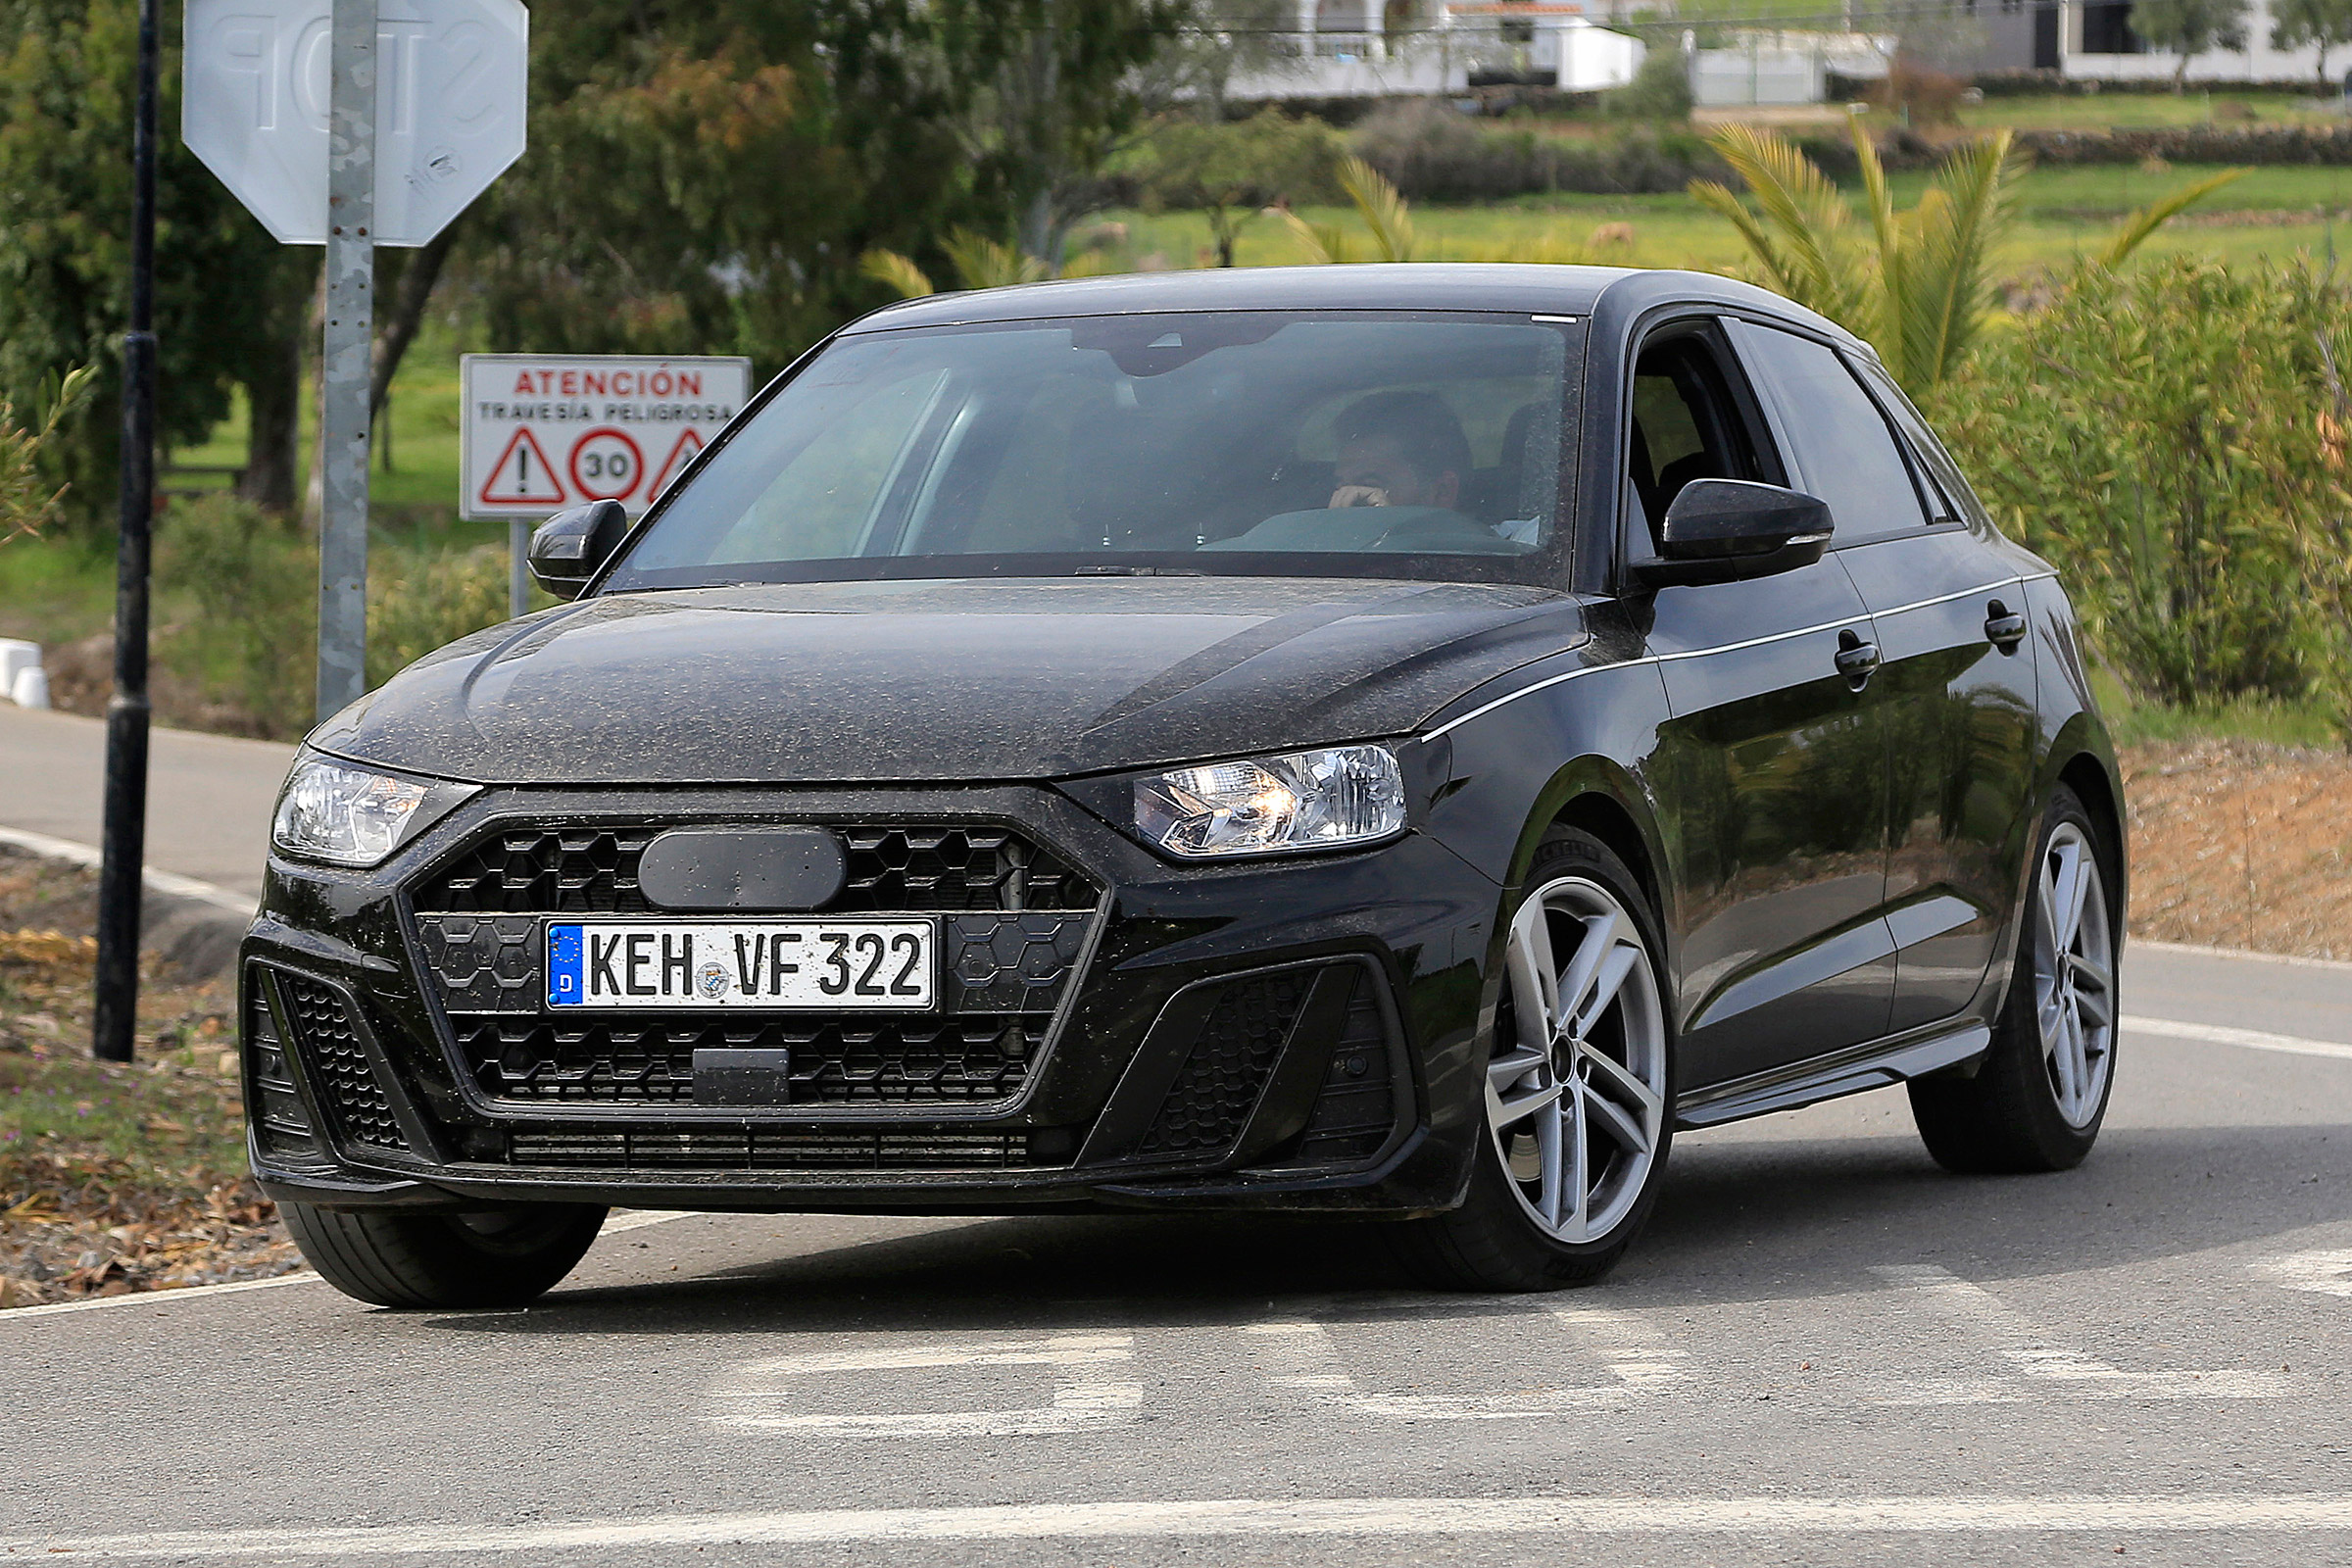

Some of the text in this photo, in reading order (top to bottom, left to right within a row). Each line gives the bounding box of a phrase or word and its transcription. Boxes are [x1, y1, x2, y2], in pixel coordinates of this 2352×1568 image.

[514, 363, 703, 397] ATENCIÓN
[479, 400, 733, 423] TRAVESÍA PELIGROSA
[585, 452, 629, 479] 30
[590, 933, 693, 996] KEH
[734, 933, 803, 996] VF
[819, 933, 922, 996] 322
[560, 974, 572, 993] D
